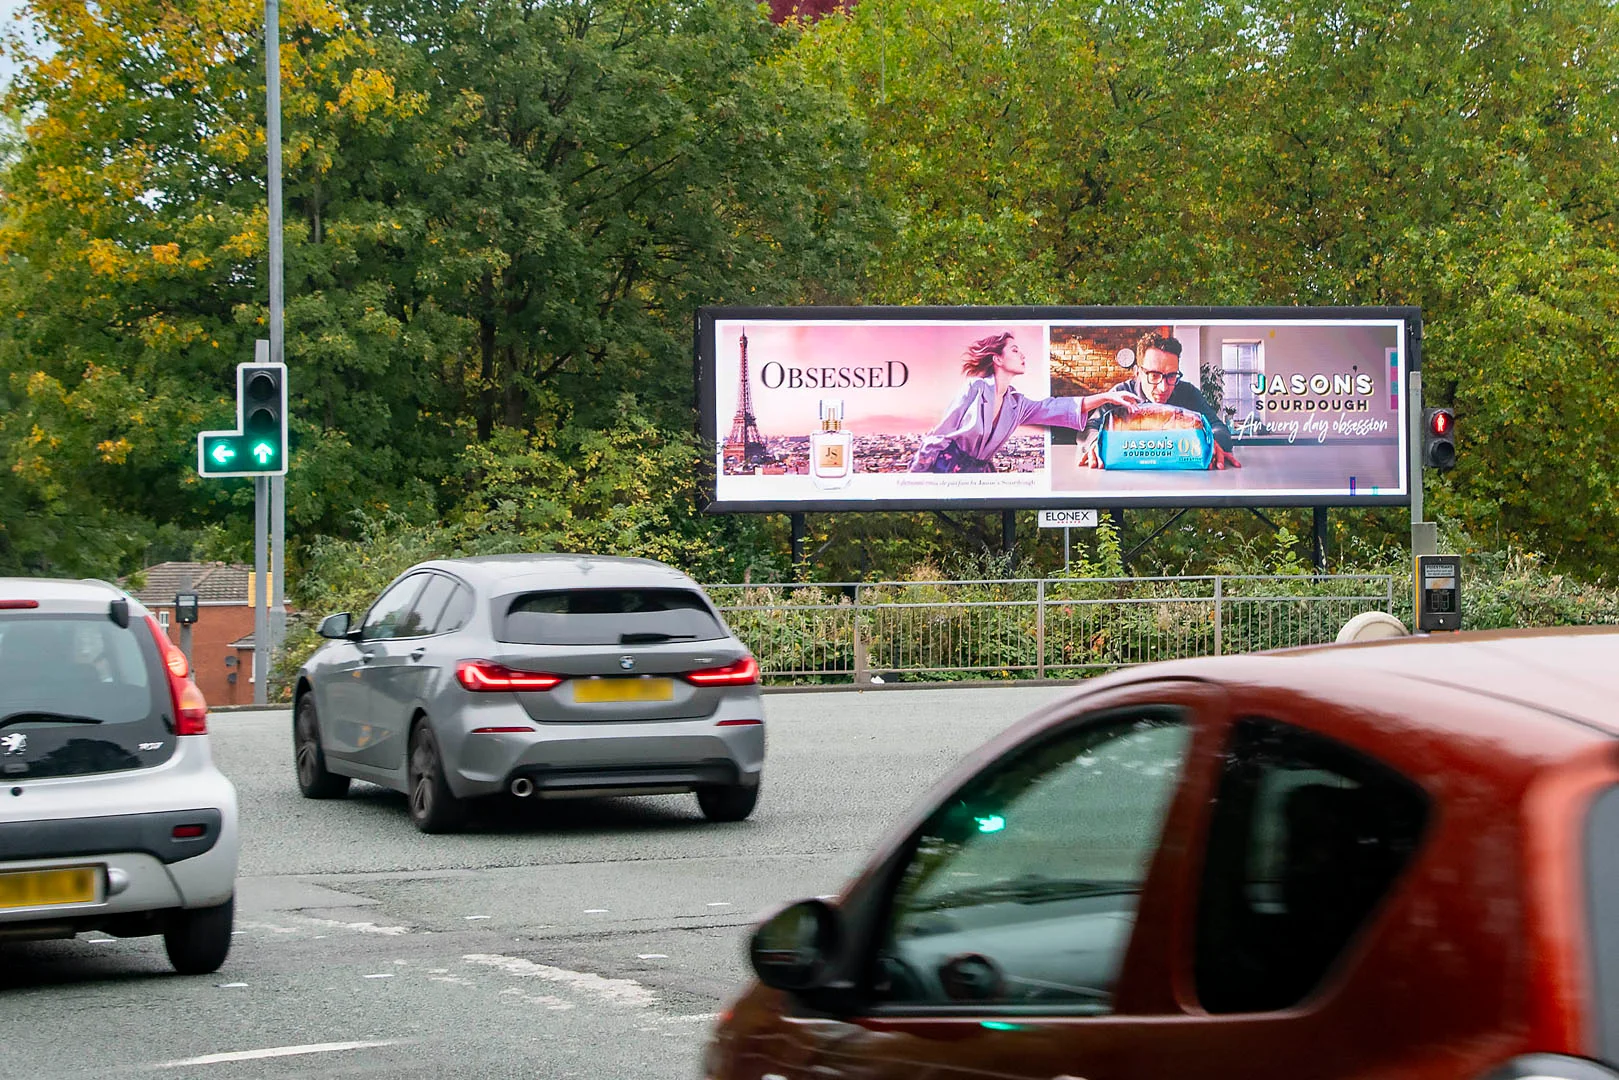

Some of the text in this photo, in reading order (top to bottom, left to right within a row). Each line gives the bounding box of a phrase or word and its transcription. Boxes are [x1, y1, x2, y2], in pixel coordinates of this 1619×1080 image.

[1250, 365, 1374, 396] JASON'S
[1256, 399, 1369, 412] SOURDOUGH
[1236, 411, 1388, 443] An every day obsession
[1122, 436, 1174, 450] JASON'S
[1045, 511, 1090, 521] ELONEX
